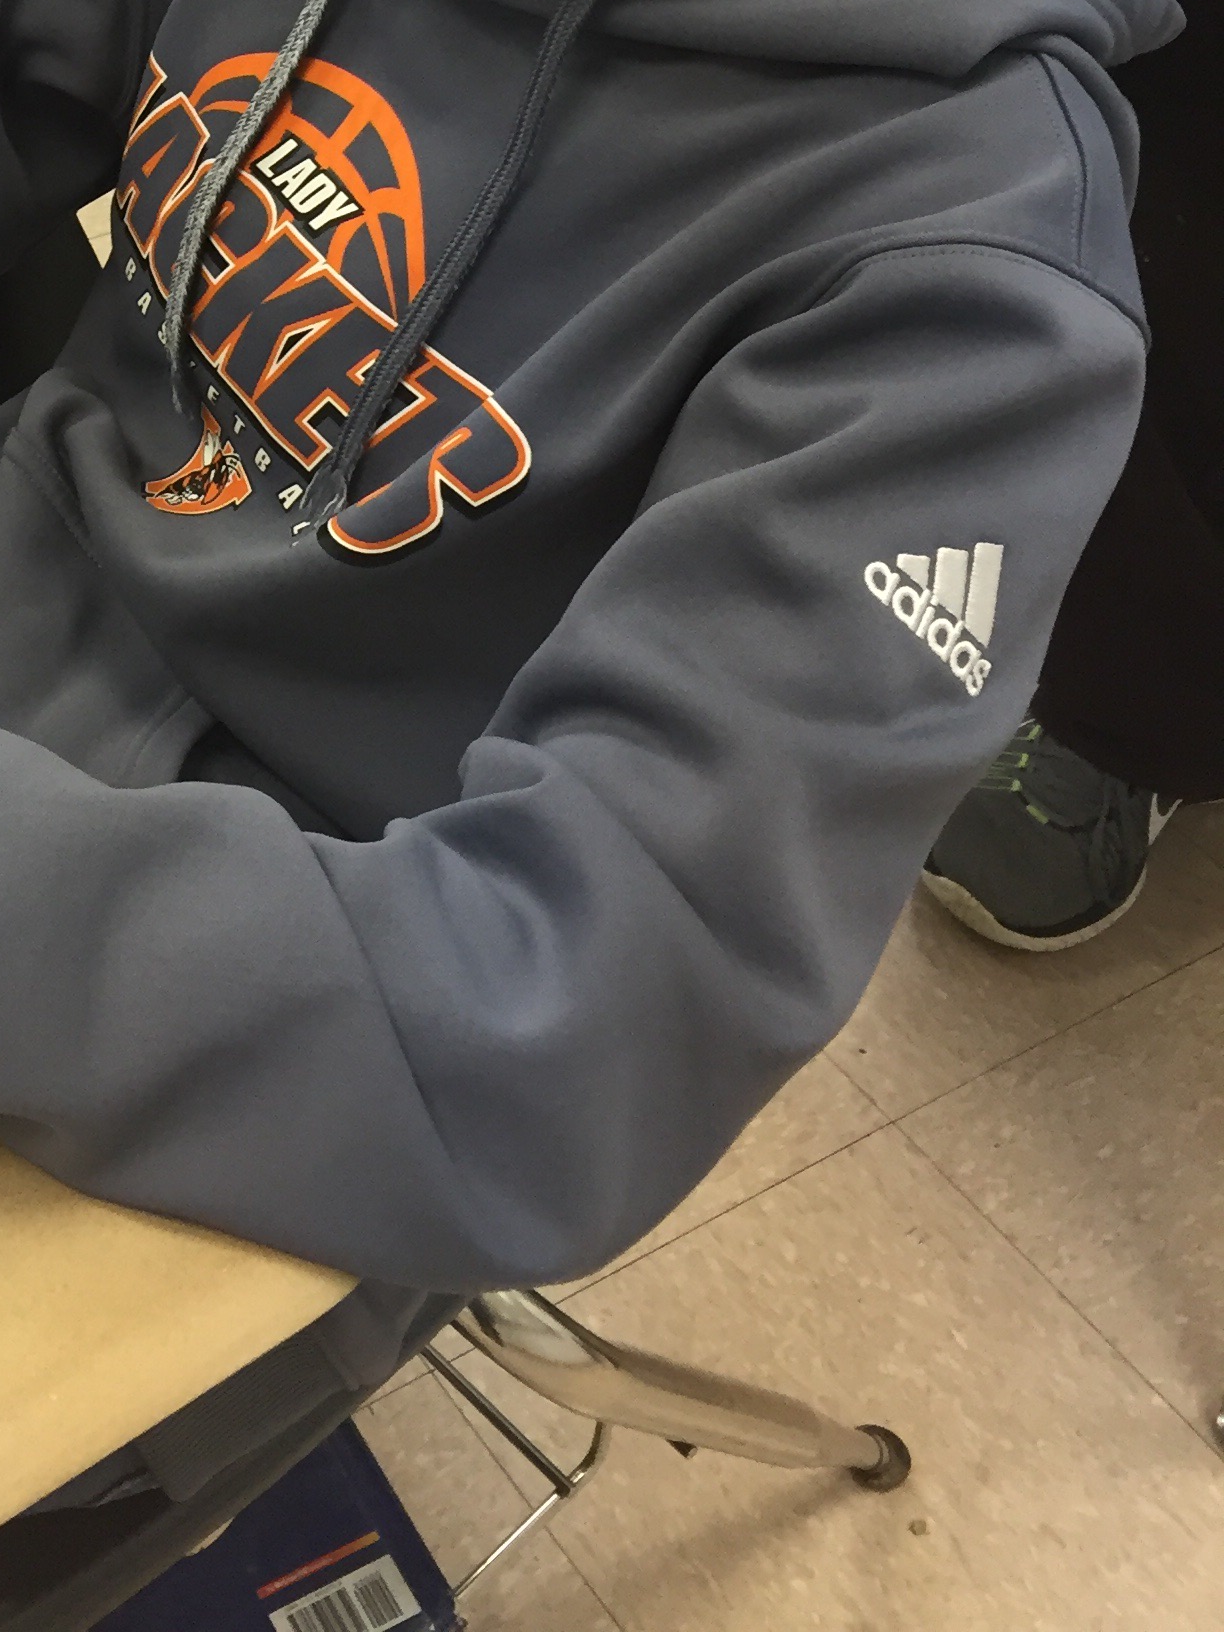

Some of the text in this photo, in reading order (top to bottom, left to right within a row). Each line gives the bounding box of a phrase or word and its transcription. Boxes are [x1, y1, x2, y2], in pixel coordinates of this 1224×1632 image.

[256, 139, 364, 231] LADY
[117, 51, 532, 555] ACKETS
[864, 561, 992, 697] adidas
